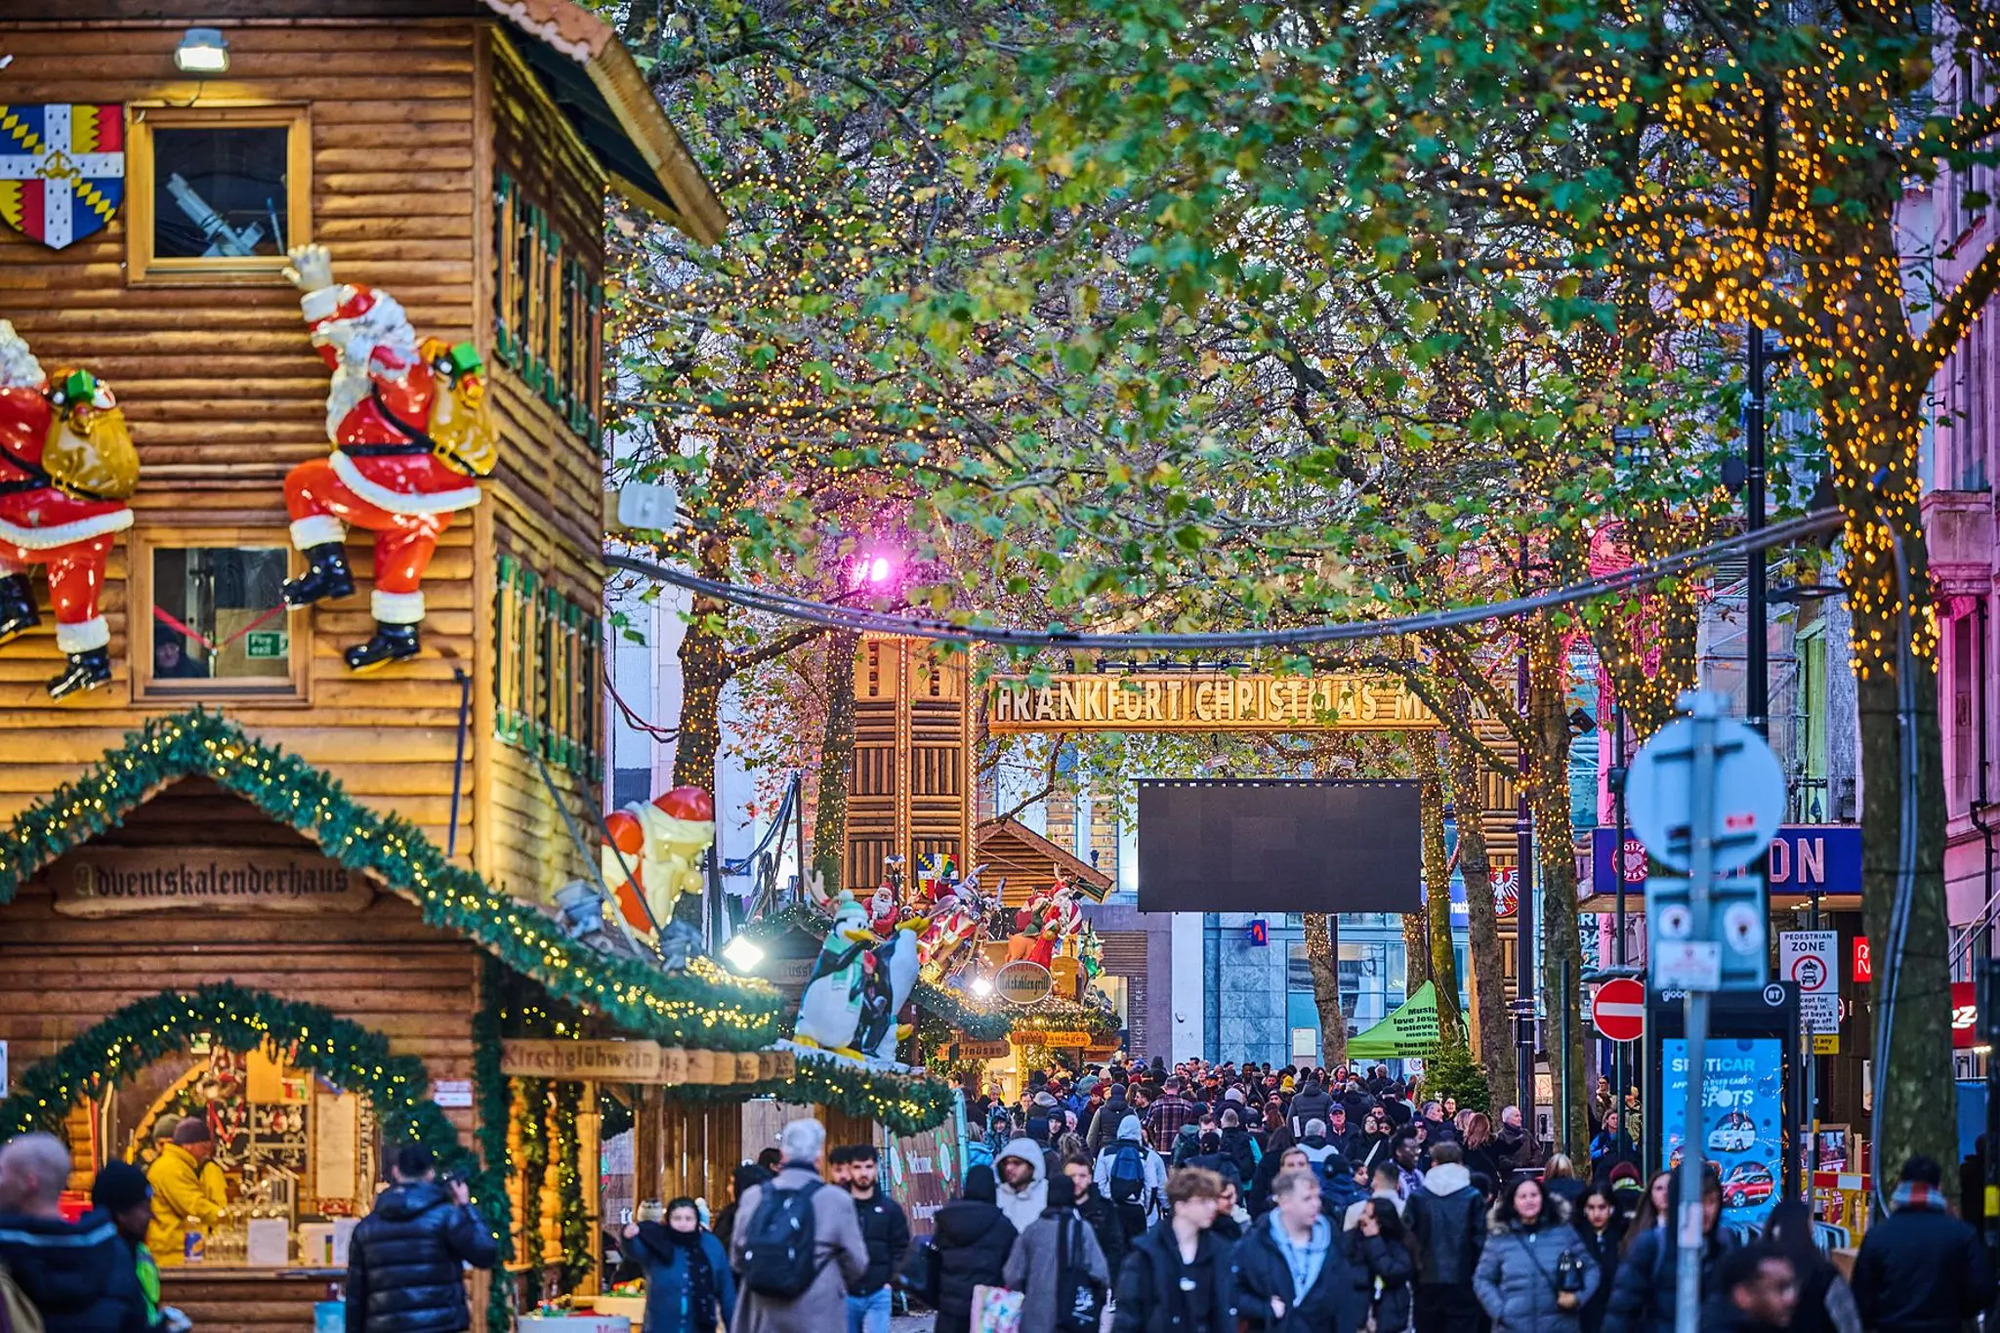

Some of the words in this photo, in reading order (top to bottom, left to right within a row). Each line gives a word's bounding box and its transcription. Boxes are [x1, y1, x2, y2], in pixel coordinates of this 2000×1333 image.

[998, 681, 1182, 721] FRANKFURT
[1195, 680, 1378, 722] CHRISTMAS
[73, 861, 350, 898] Adventskalenderhaus
[1792, 942, 1825, 951] ZONE
